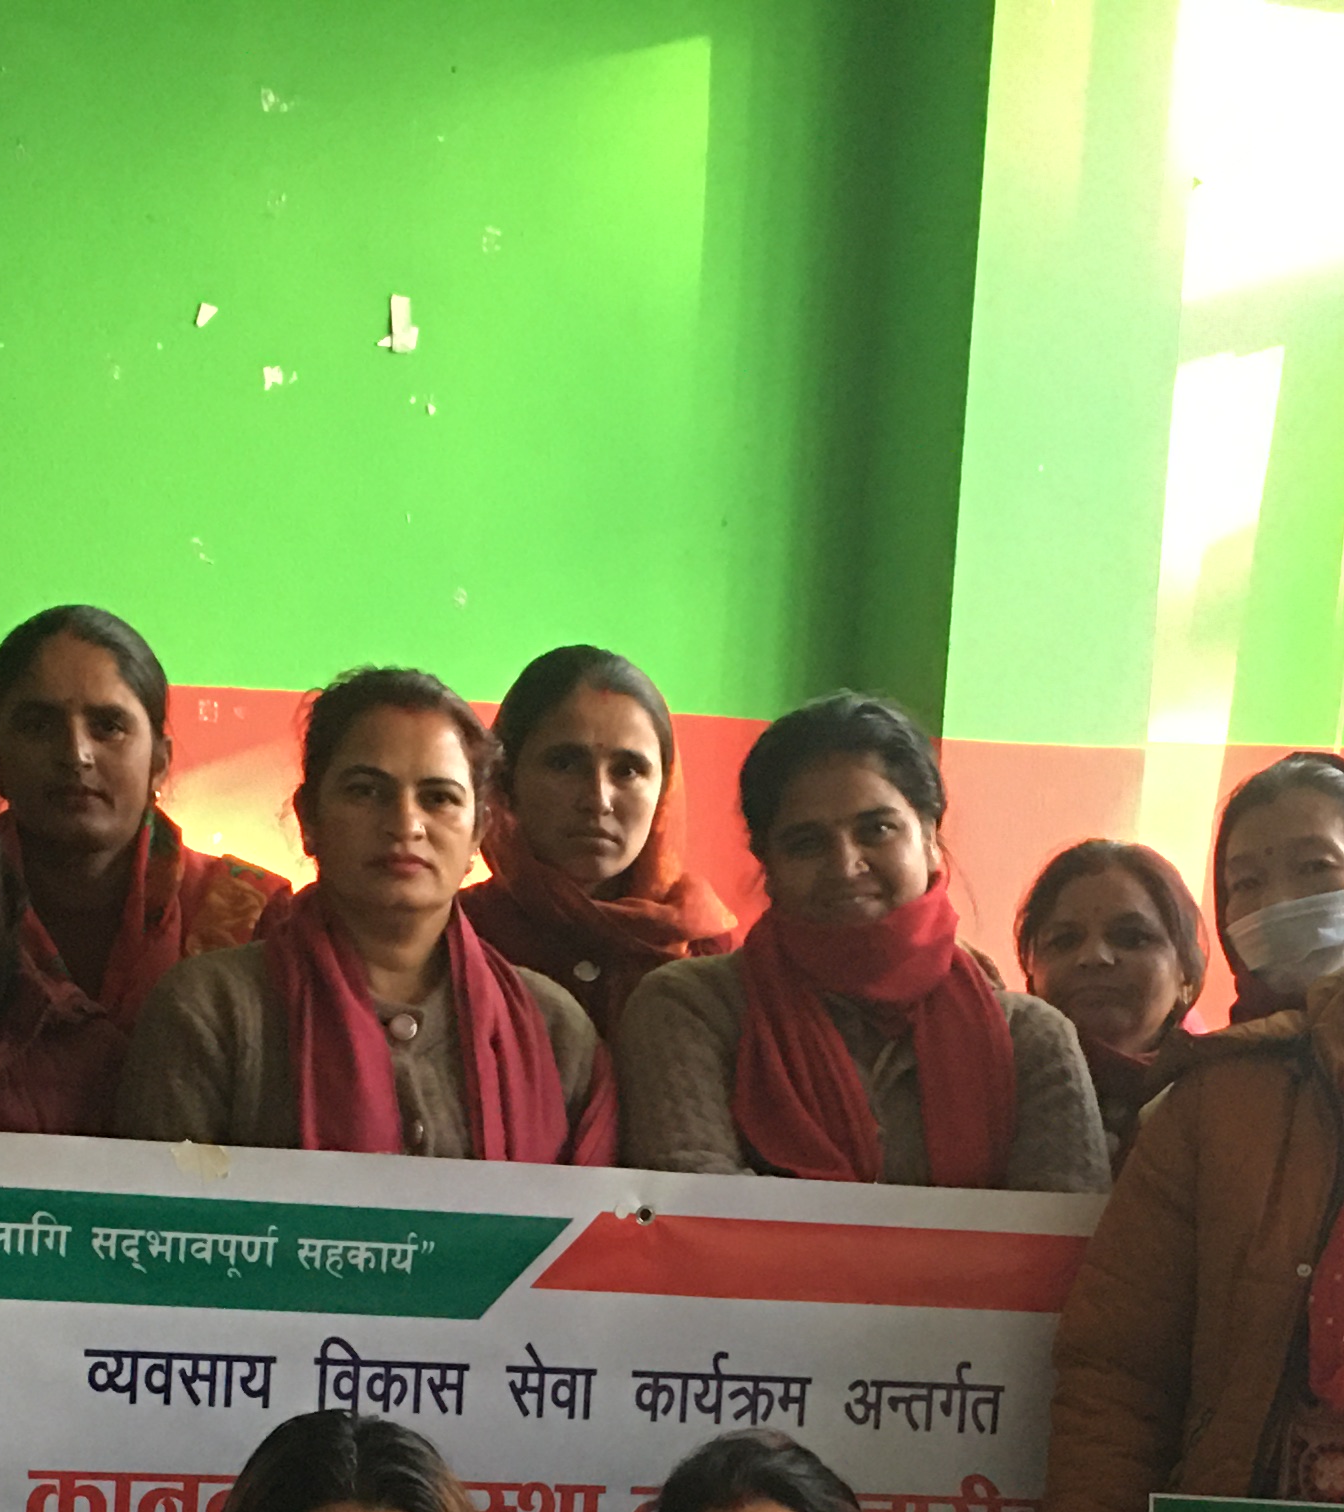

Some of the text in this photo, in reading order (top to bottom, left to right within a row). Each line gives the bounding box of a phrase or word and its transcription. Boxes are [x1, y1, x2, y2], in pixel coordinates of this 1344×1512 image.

[84, 1337, 1004, 1435] व्यवसाय विकास सेवा कार्यक्रम अन्तर्गत
